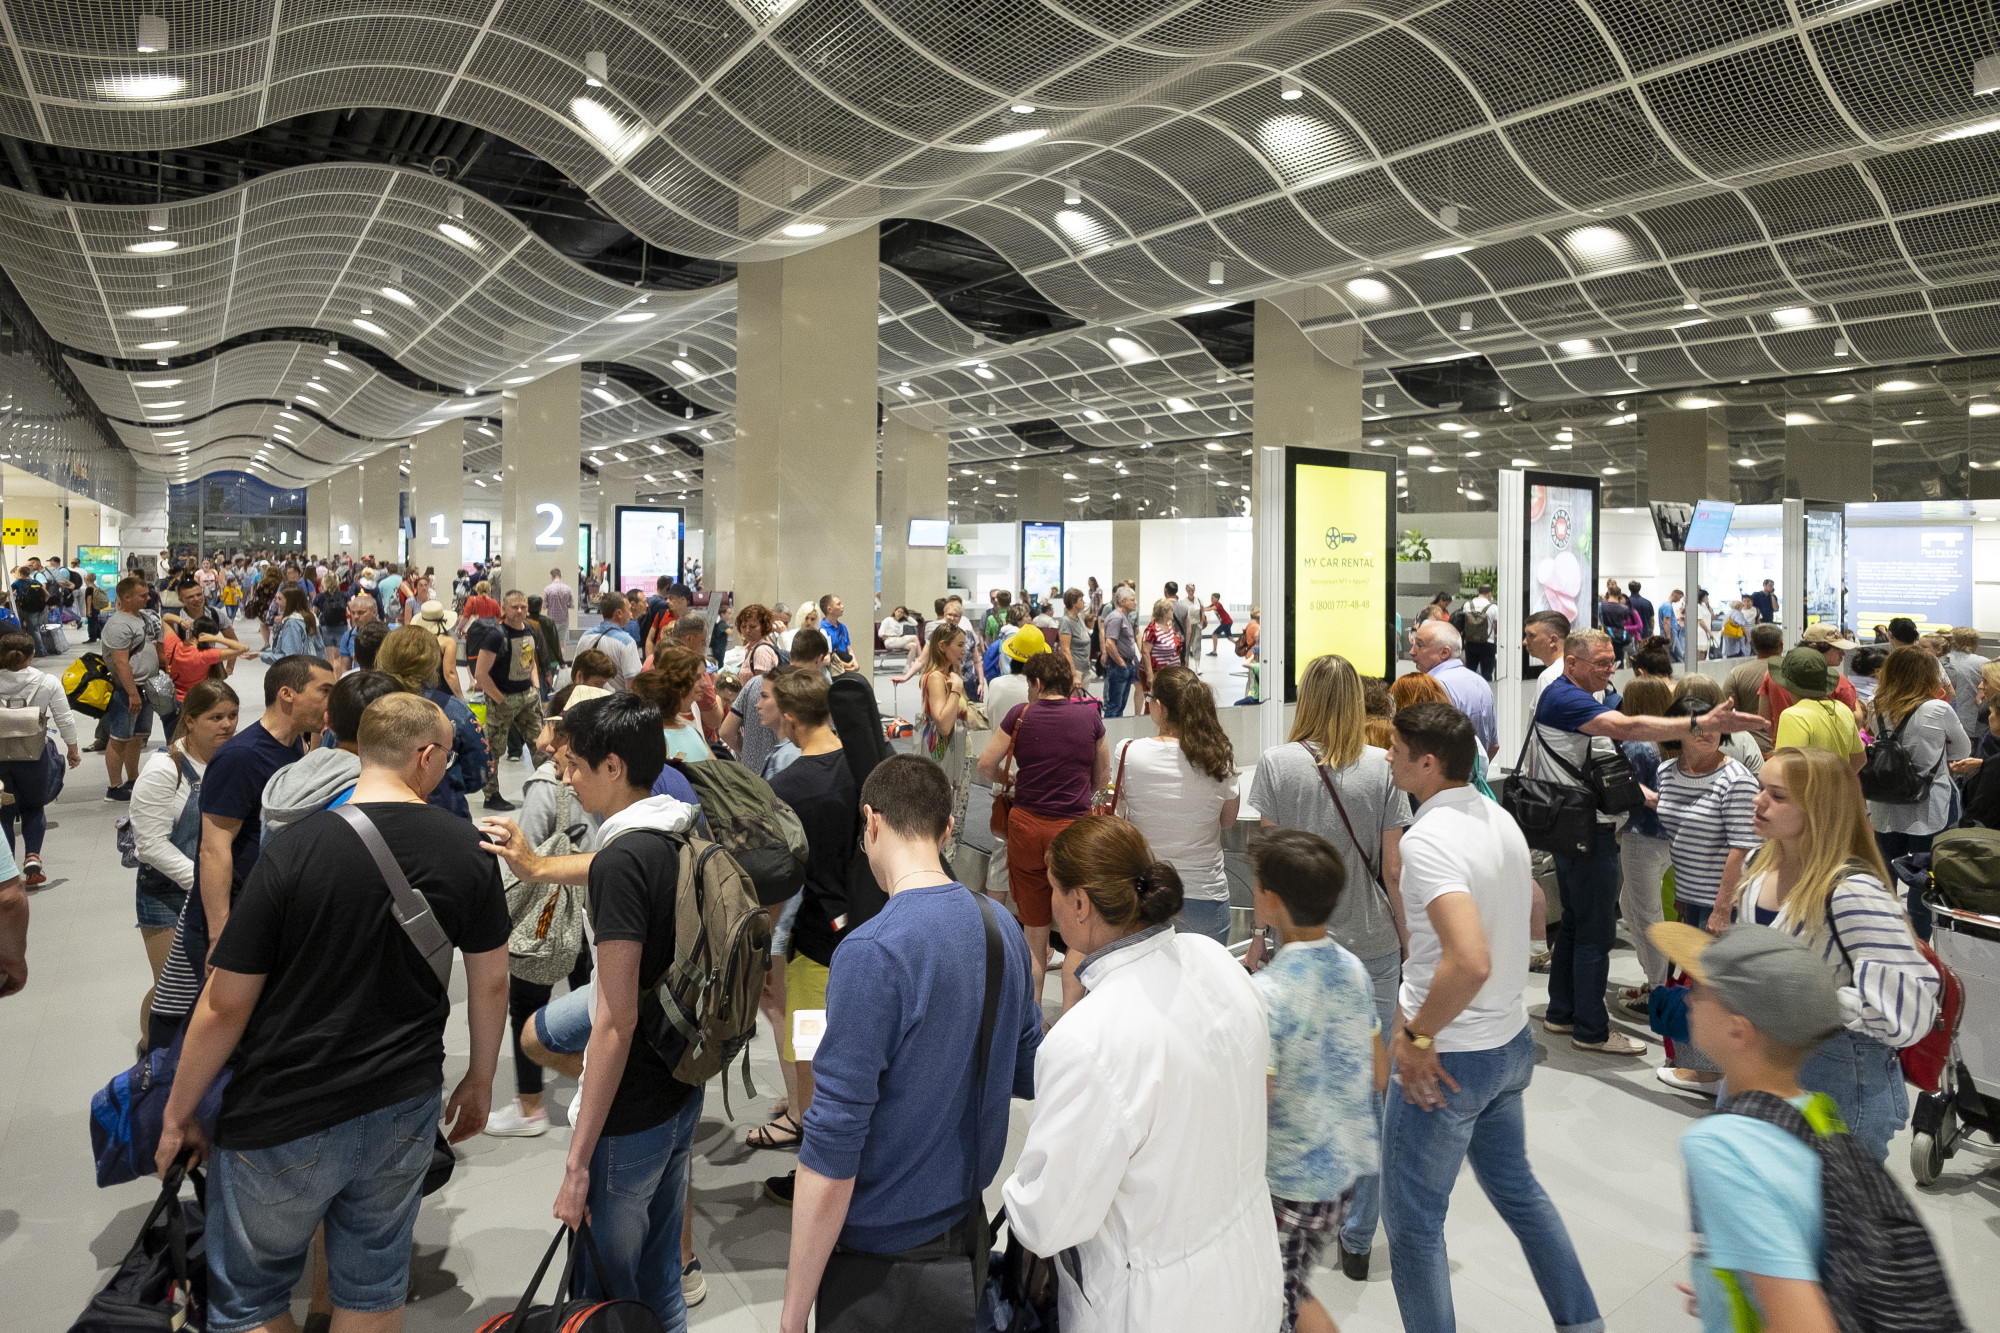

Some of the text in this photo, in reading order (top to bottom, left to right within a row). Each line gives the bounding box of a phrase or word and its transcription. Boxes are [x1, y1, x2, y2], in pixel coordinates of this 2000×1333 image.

[339, 524, 352, 544] 1
[430, 514, 449, 544] 1
[535, 503, 563, 545] 2
[1304, 558, 1374, 568] MY CAR RENTAL
[1310, 600, 1370, 611] 8 (800) 777-48-48
